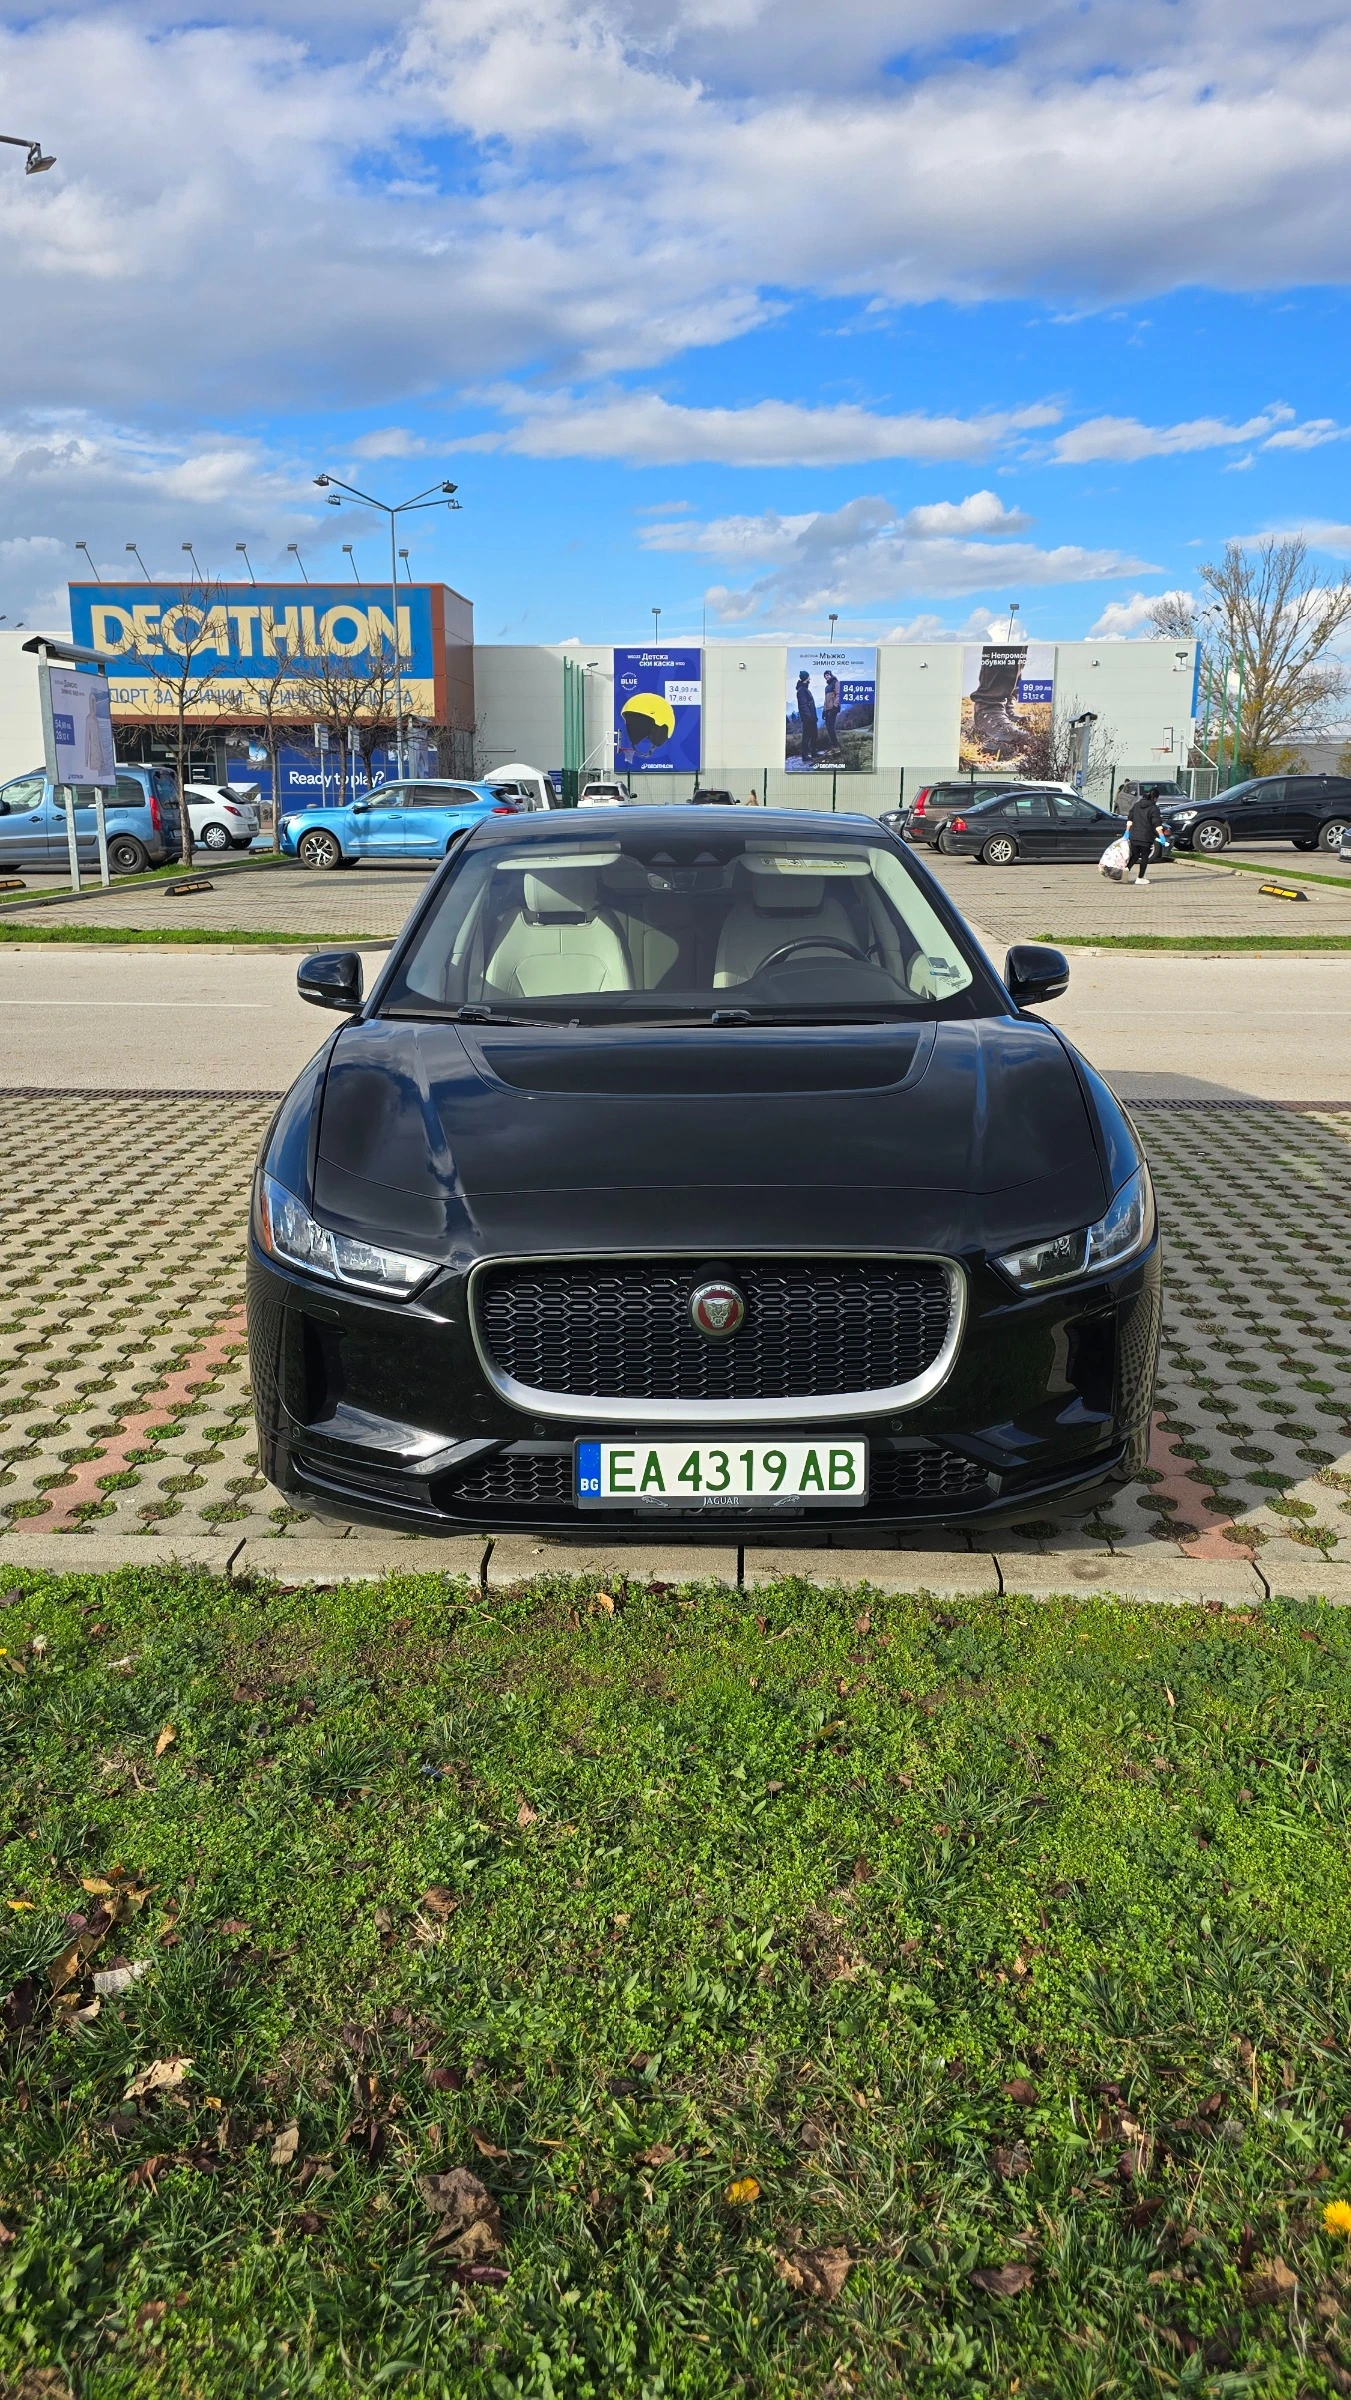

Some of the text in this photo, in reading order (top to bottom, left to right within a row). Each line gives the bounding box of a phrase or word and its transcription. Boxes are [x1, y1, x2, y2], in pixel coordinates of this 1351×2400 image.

[90, 605, 412, 657] DECATHLON
[642, 653, 668, 661] Детска
[991, 652, 1028, 660] Непромок
[669, 686, 689, 694] 34,99
[843, 685, 864, 693] 84,99
[1023, 683, 1044, 692] 99,99
[109, 688, 149, 704] ПОРТ
[153, 688, 174, 704] ЗА
[843, 694, 864, 702] 43,45
[1022, 692, 1039, 701] 51,12
[289, 771, 332, 788] Ready
[351, 770, 385, 788] play?
[580, 1449, 856, 1492] BG EA 4319 AB
[703, 1496, 740, 1506] JAGUAR
